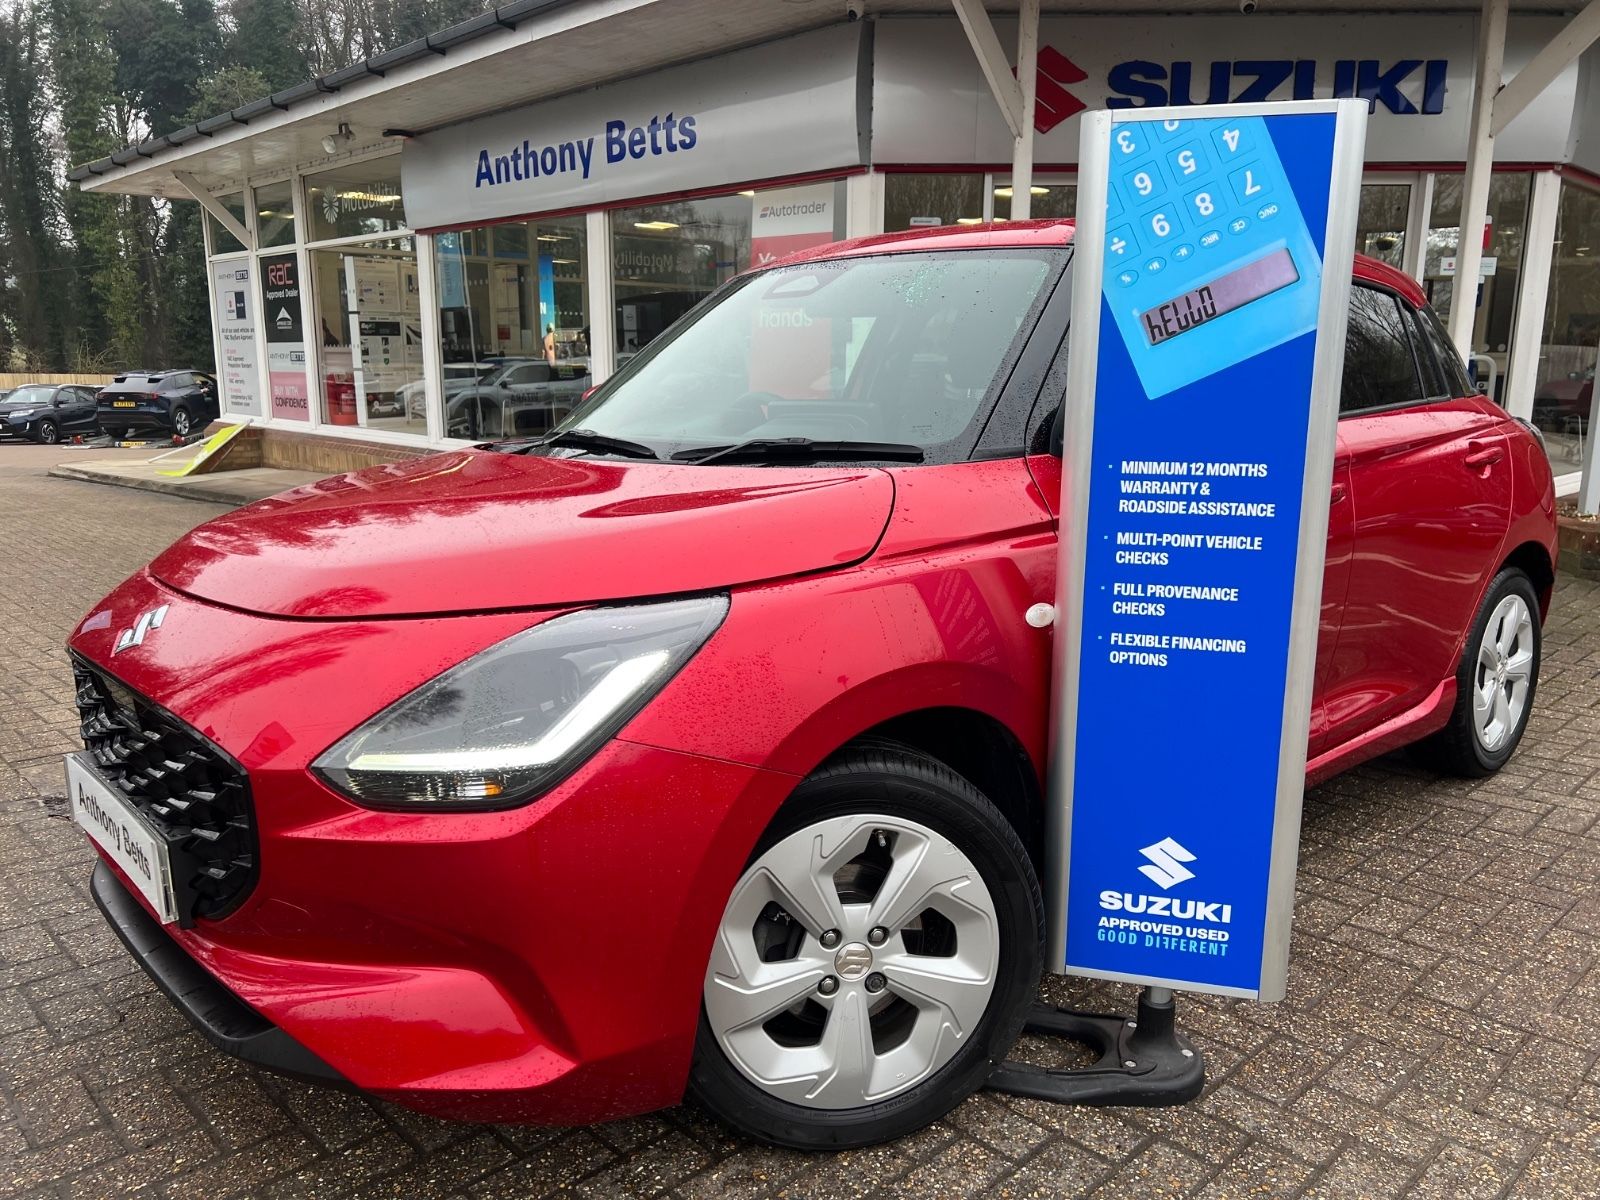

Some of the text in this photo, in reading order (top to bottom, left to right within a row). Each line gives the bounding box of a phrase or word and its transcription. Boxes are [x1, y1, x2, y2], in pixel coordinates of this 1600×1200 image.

[1106, 60, 1448, 115] SUZUKI
[475, 111, 697, 188] Anthony Betts
[1117, 131, 1136, 154] 3
[1222, 129, 1240, 152] 4
[1178, 150, 1197, 175] 5
[1245, 170, 1262, 196] 7
[768, 200, 827, 218] Autotrader
[1195, 192, 1214, 216] 8
[266, 288, 298, 300] Approved Dealer
[759, 307, 814, 328] hands
[275, 397, 307, 409] CONFIDENCE
[1121, 460, 1268, 477] MINIMUM 12 MONTHS
[1120, 480, 1210, 495] WARRANTY &
[1119, 500, 1276, 517] ROADSIDE ASSISTANCE
[1116, 532, 1263, 550] MULTI-POINT VEHICLE
[1115, 551, 1169, 565] CHECKS
[1113, 582, 1239, 602] FULL PROVENANCE
[1112, 601, 1166, 616] CHECKS
[1110, 632, 1247, 653] FLEXIBLE FINANCING
[1109, 651, 1168, 667] OPTIONS
[78, 781, 152, 881] Anthony Betts
[1099, 890, 1232, 923] SUZUKI
[1098, 916, 1230, 942] APPROVED USED
[1097, 928, 1228, 957] GOOD DIFFERENT
